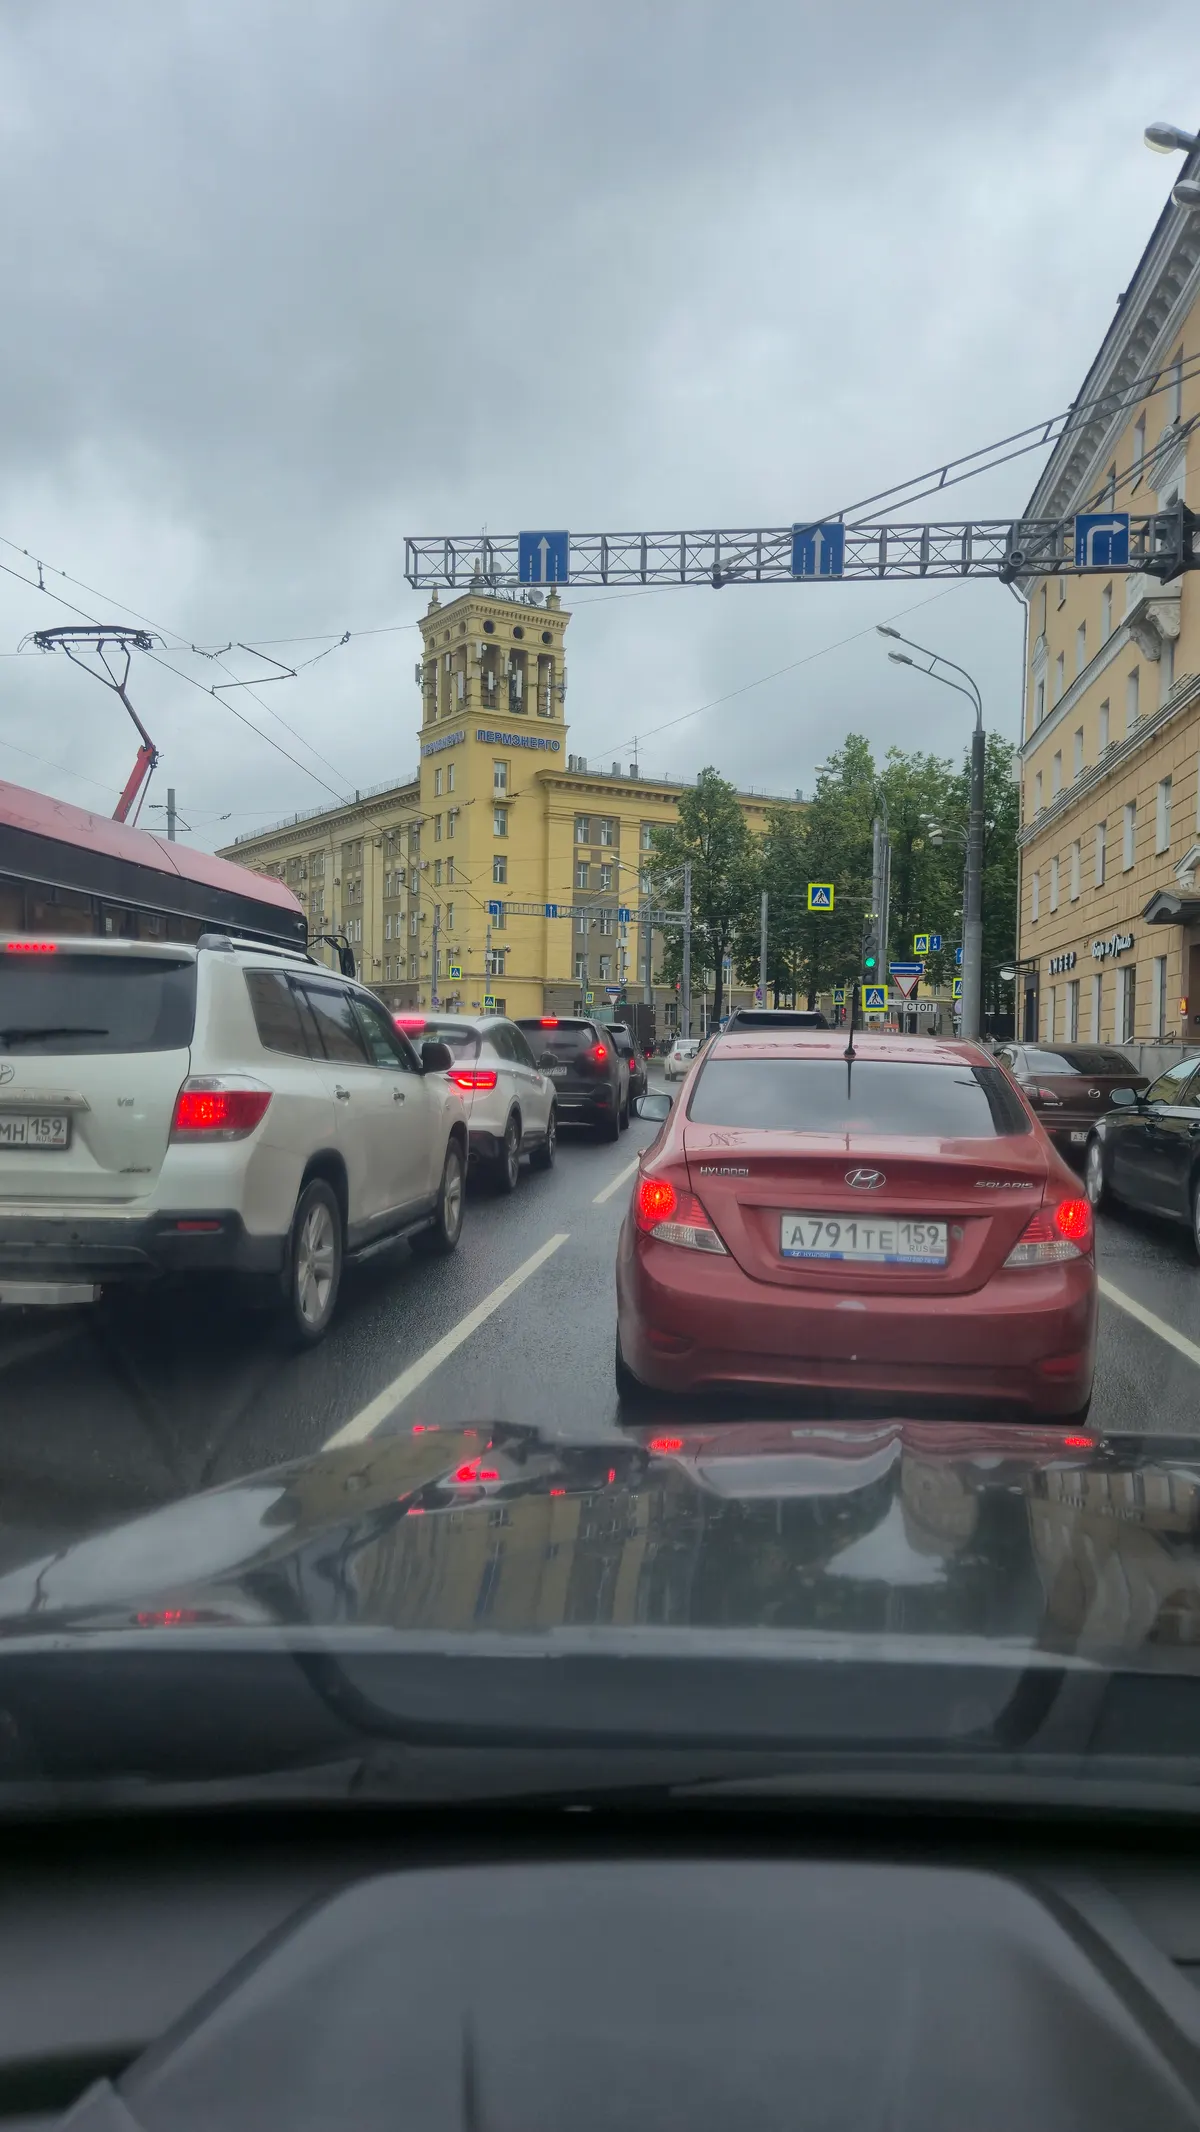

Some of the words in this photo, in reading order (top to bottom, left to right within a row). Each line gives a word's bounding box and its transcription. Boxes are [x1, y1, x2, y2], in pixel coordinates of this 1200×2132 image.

[476, 729, 560, 752] ПЕРМЭНЕРГО
[906, 1003, 934, 1012] СТОП
[31, 1118, 62, 1136] 159
[700, 1166, 749, 1177] HYUNDAI
[974, 1181, 1034, 1189] SOLARIS
[901, 1223, 940, 1246] 159
[909, 1245, 929, 1253] RUS
